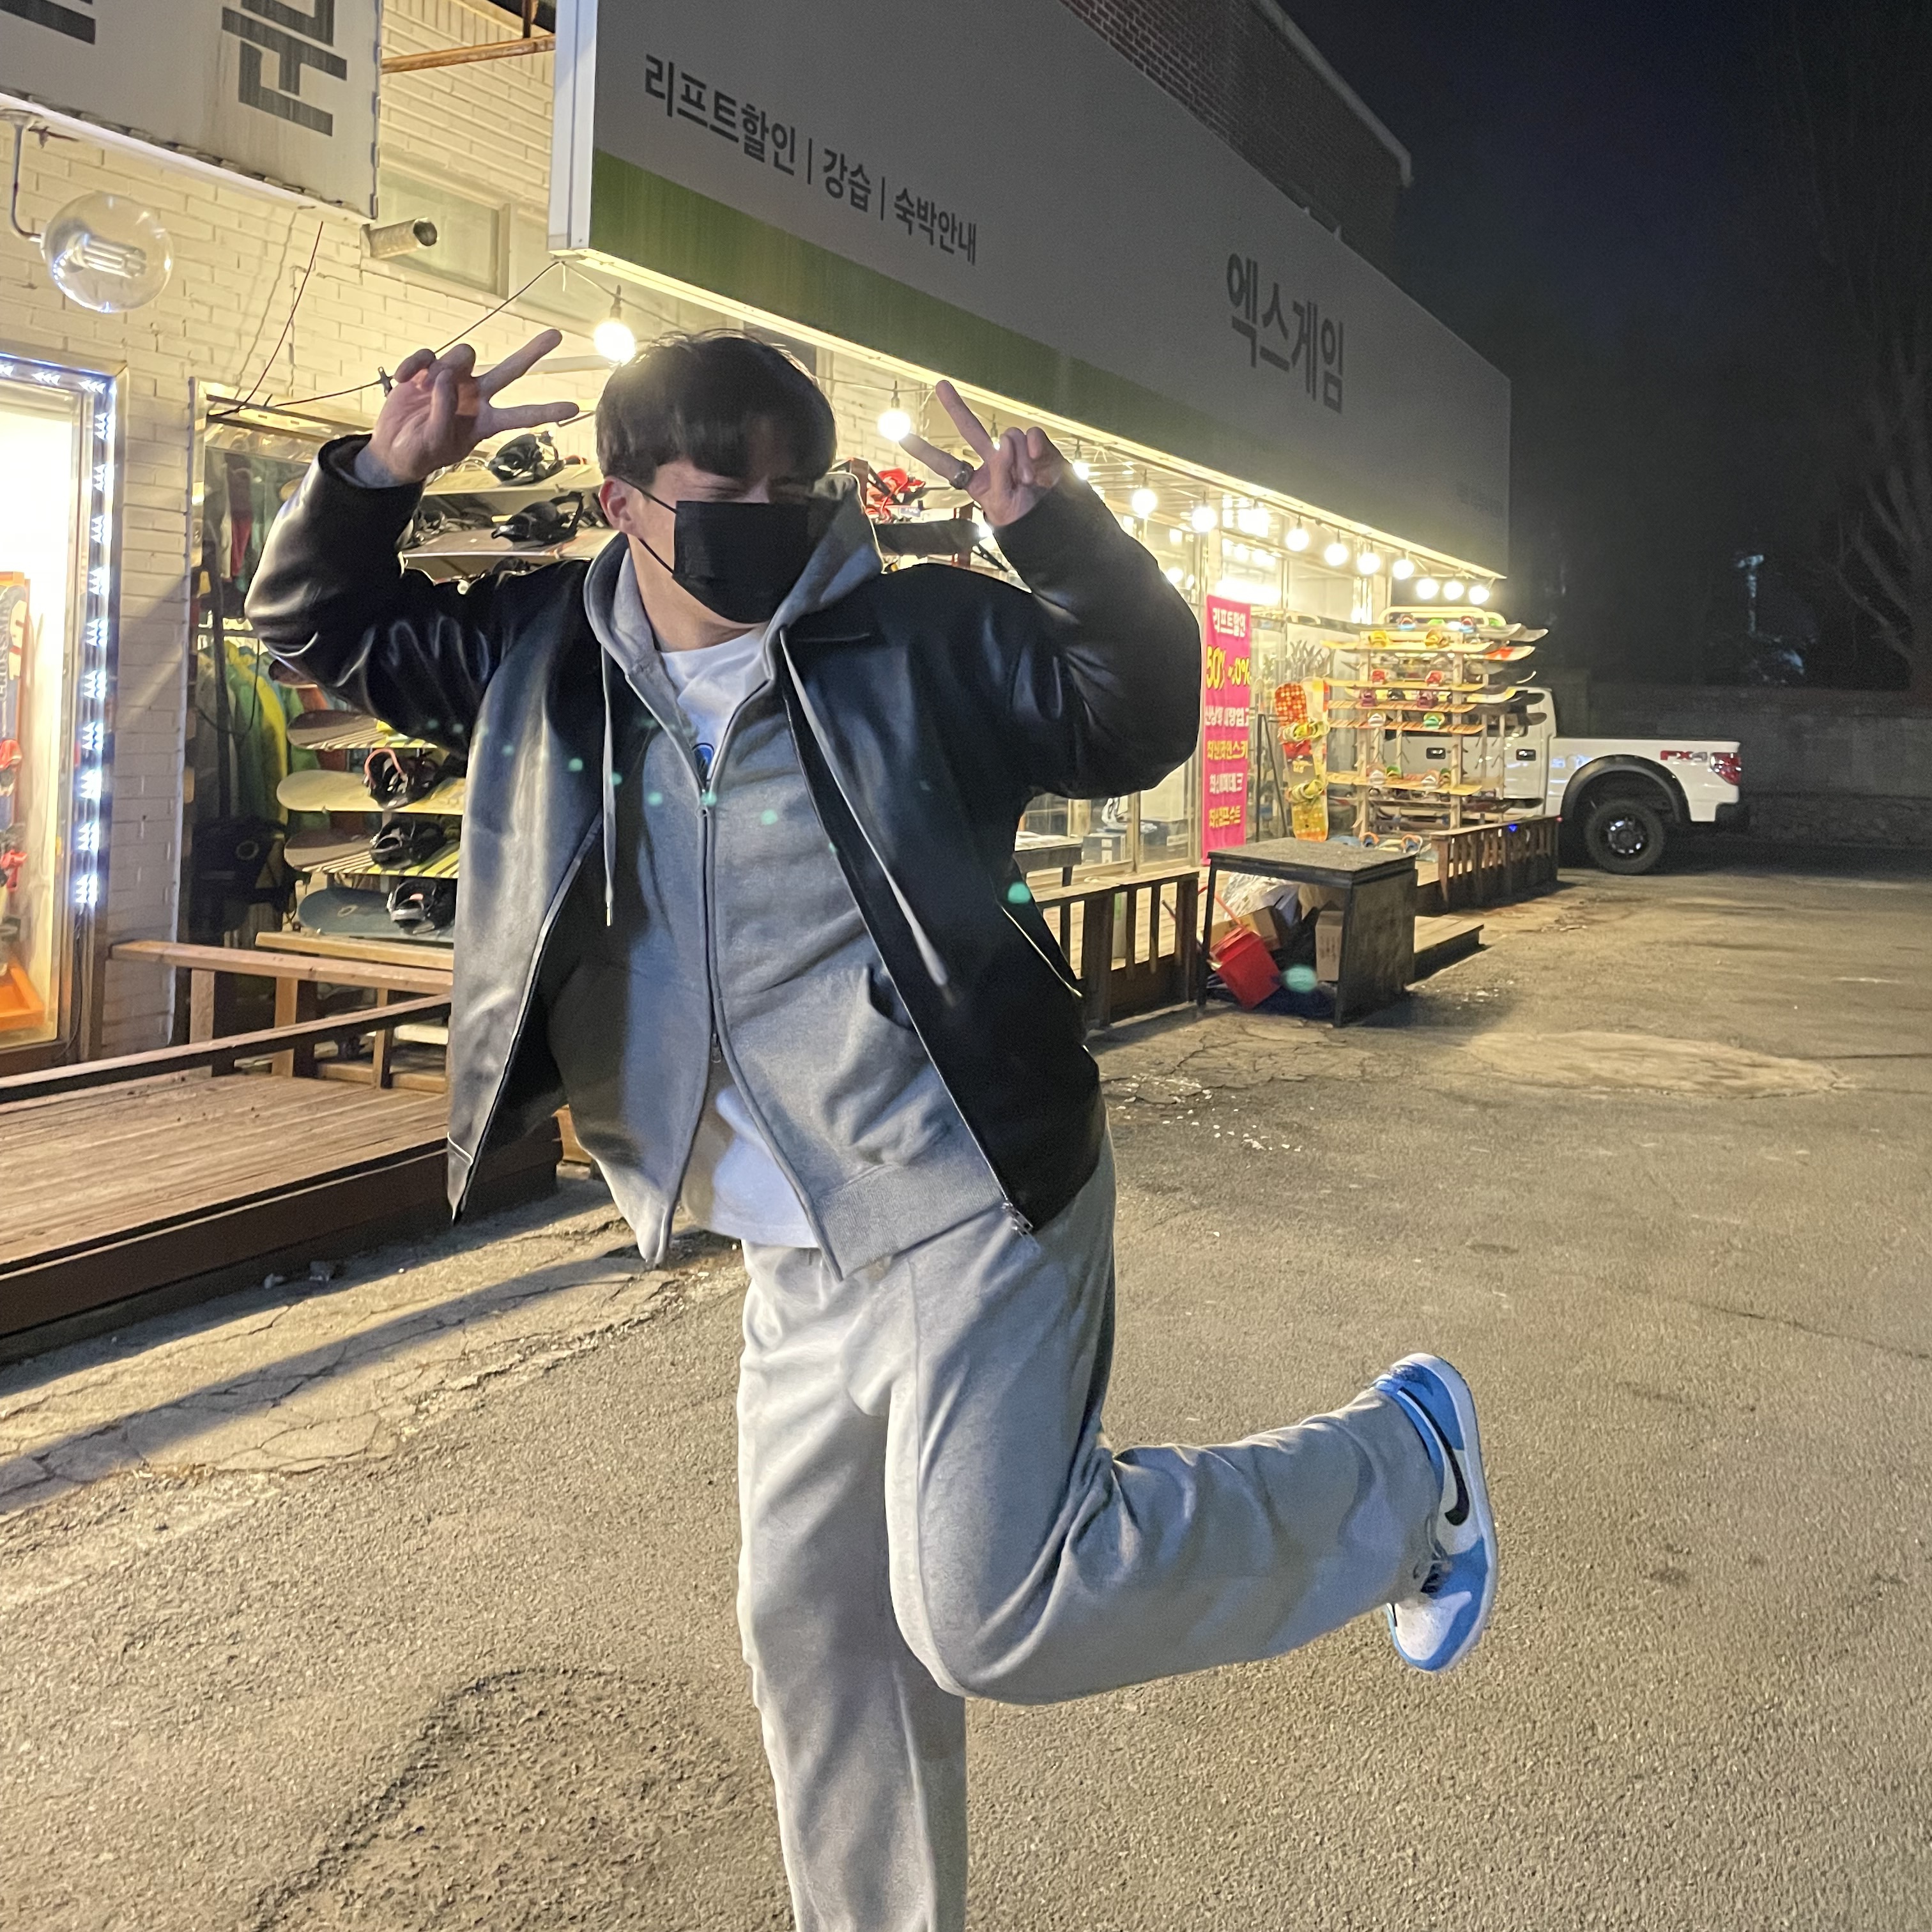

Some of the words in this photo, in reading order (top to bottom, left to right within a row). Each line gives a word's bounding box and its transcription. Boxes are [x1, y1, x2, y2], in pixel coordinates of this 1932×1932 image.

[645, 54, 796, 176] 리프트할인
[823, 148, 872, 213] 강습
[894, 187, 977, 266] 숙박안내
[1227, 253, 1344, 415] 엑스게임
[1212, 607, 1246, 638] 리프트할인
[1660, 750, 1708, 762] FX4
